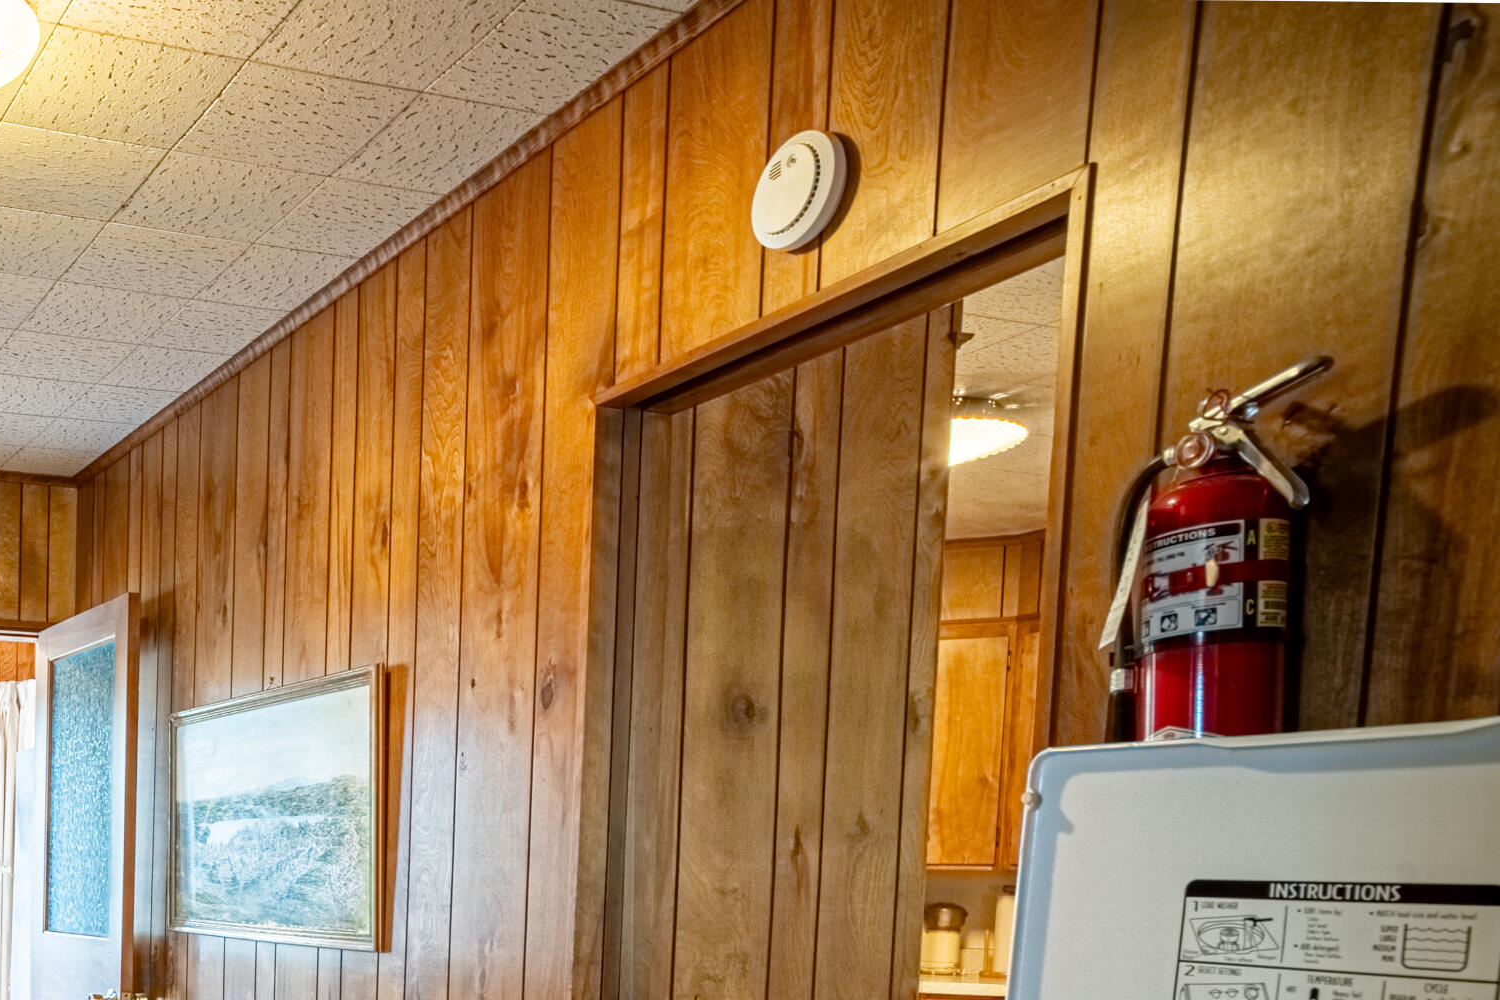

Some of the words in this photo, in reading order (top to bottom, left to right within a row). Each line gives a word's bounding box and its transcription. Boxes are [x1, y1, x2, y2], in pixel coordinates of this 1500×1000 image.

[1147, 528, 1216, 550] STRUCTIONS
[1247, 530, 1256, 545] A
[1246, 599, 1255, 614] C
[1268, 882, 1401, 901] INSTRUCTIONS
[1193, 901, 1198, 912] 1
[1184, 965, 1195, 976] 2
[1307, 975, 1353, 986] TEMPERATURE
[1424, 983, 1449, 994] CYCLE
